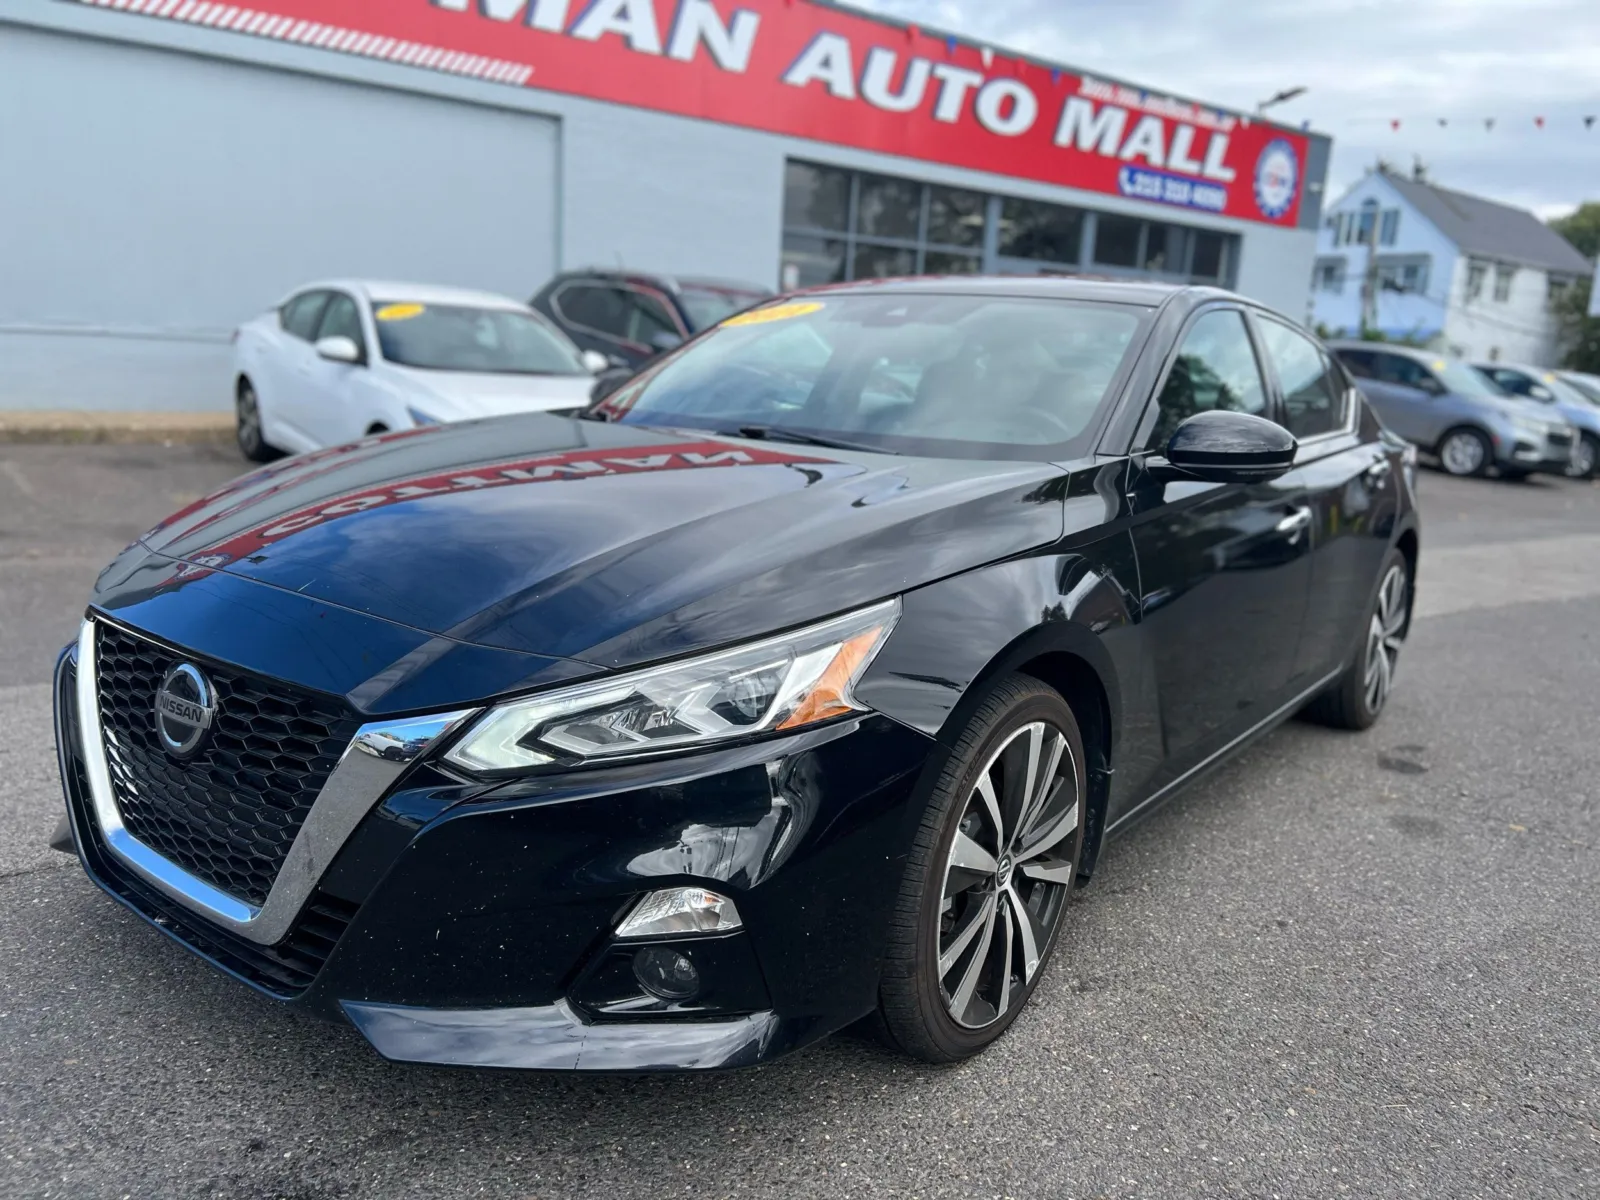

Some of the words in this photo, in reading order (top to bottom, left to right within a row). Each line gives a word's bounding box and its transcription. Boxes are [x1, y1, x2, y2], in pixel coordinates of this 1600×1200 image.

[780, 30, 1039, 136] AUTO
[1053, 95, 1236, 182] MALL
[160, 695, 203, 722] NISSAN
